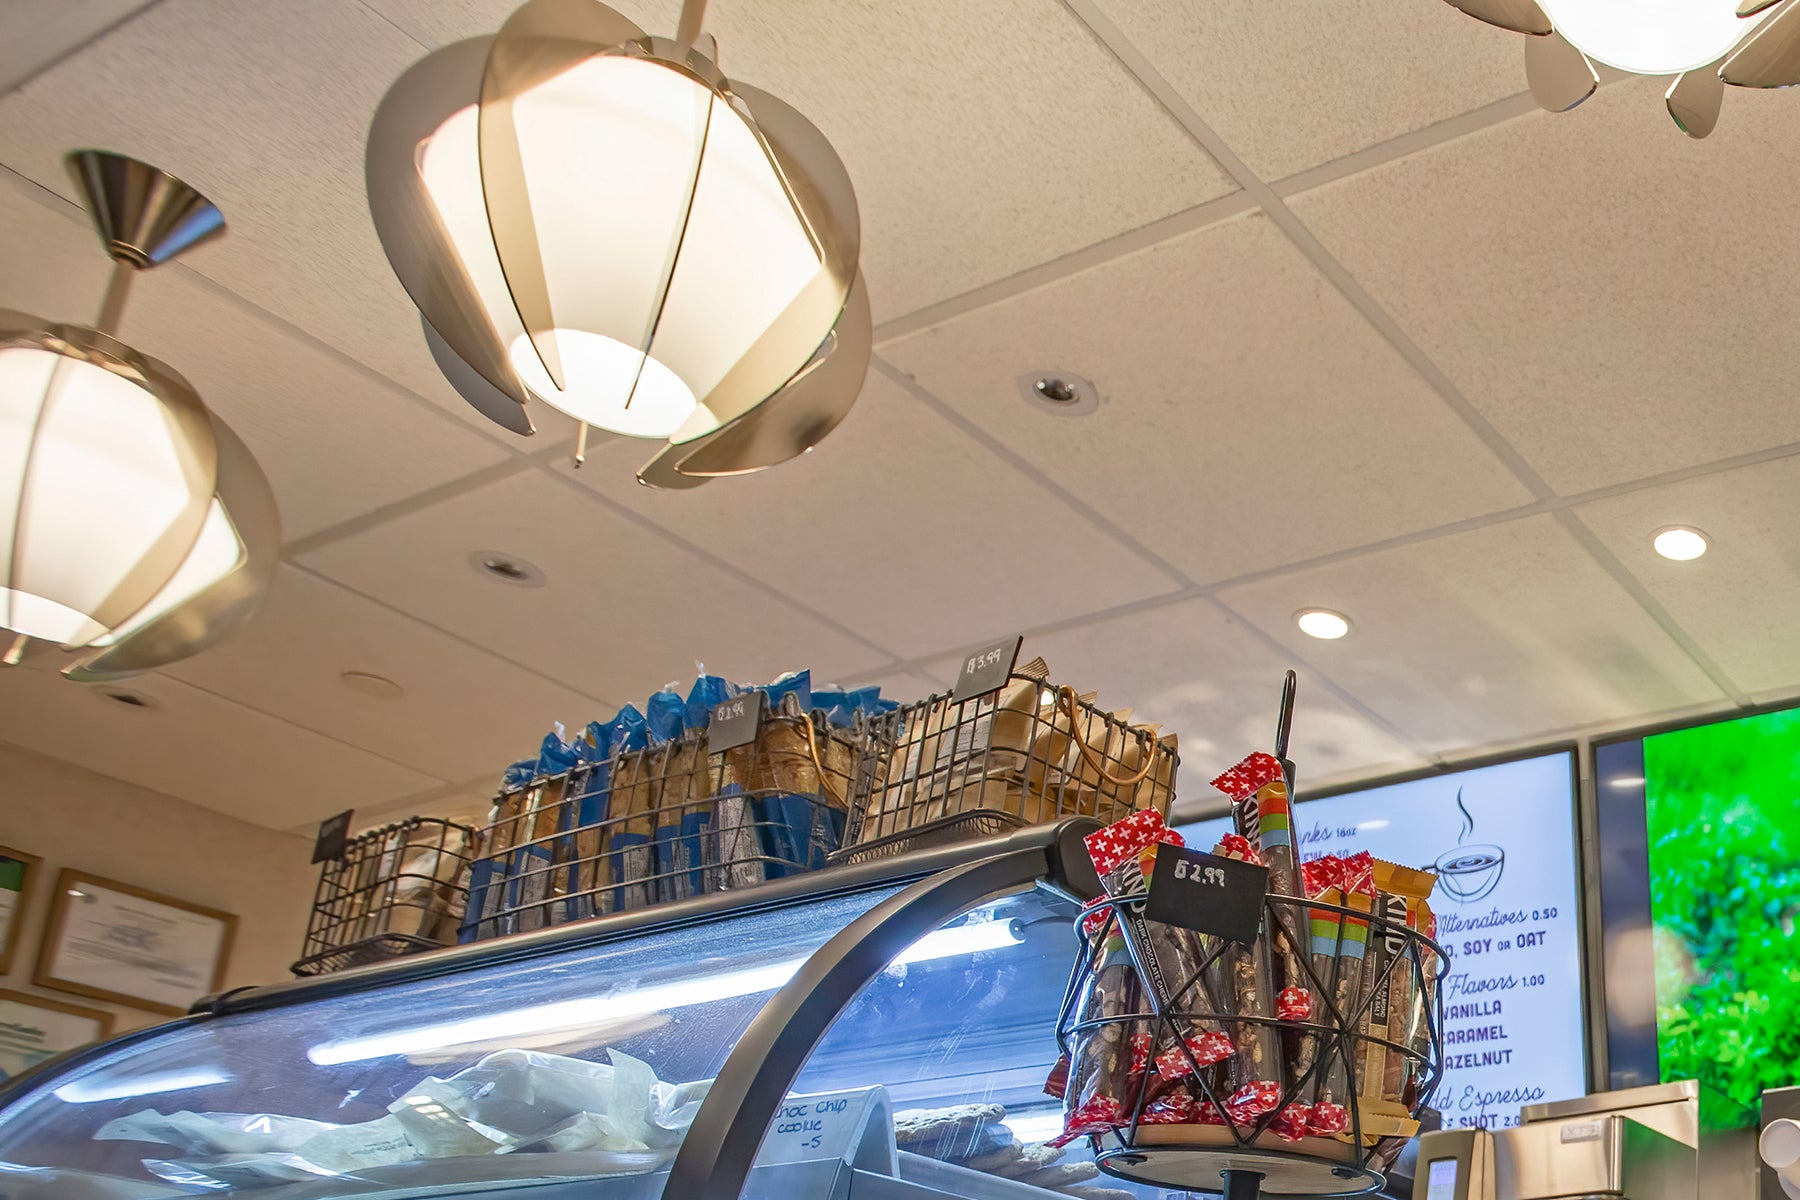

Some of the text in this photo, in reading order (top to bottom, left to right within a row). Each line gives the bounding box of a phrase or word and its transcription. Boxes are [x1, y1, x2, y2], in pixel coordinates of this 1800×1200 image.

[1174, 858, 1225, 888] $2.99
[1532, 907, 1558, 921] 0.50
[1463, 938, 1492, 956] SOY
[1497, 940, 1511, 952] OR
[1516, 931, 1546, 949] OAT
[1143, 939, 1160, 982] CHOCOLATE
[1156, 981, 1169, 1006] CHERR
[1448, 972, 1545, 1000] Flavors 1.00
[1443, 1000, 1502, 1020] VANILLA
[1443, 1025, 1508, 1045] ARAMEL
[1445, 1049, 1513, 1070] AZELNUT
[1459, 1084, 1545, 1117] Espresso
[1460, 1114, 1498, 1129] SHOT
